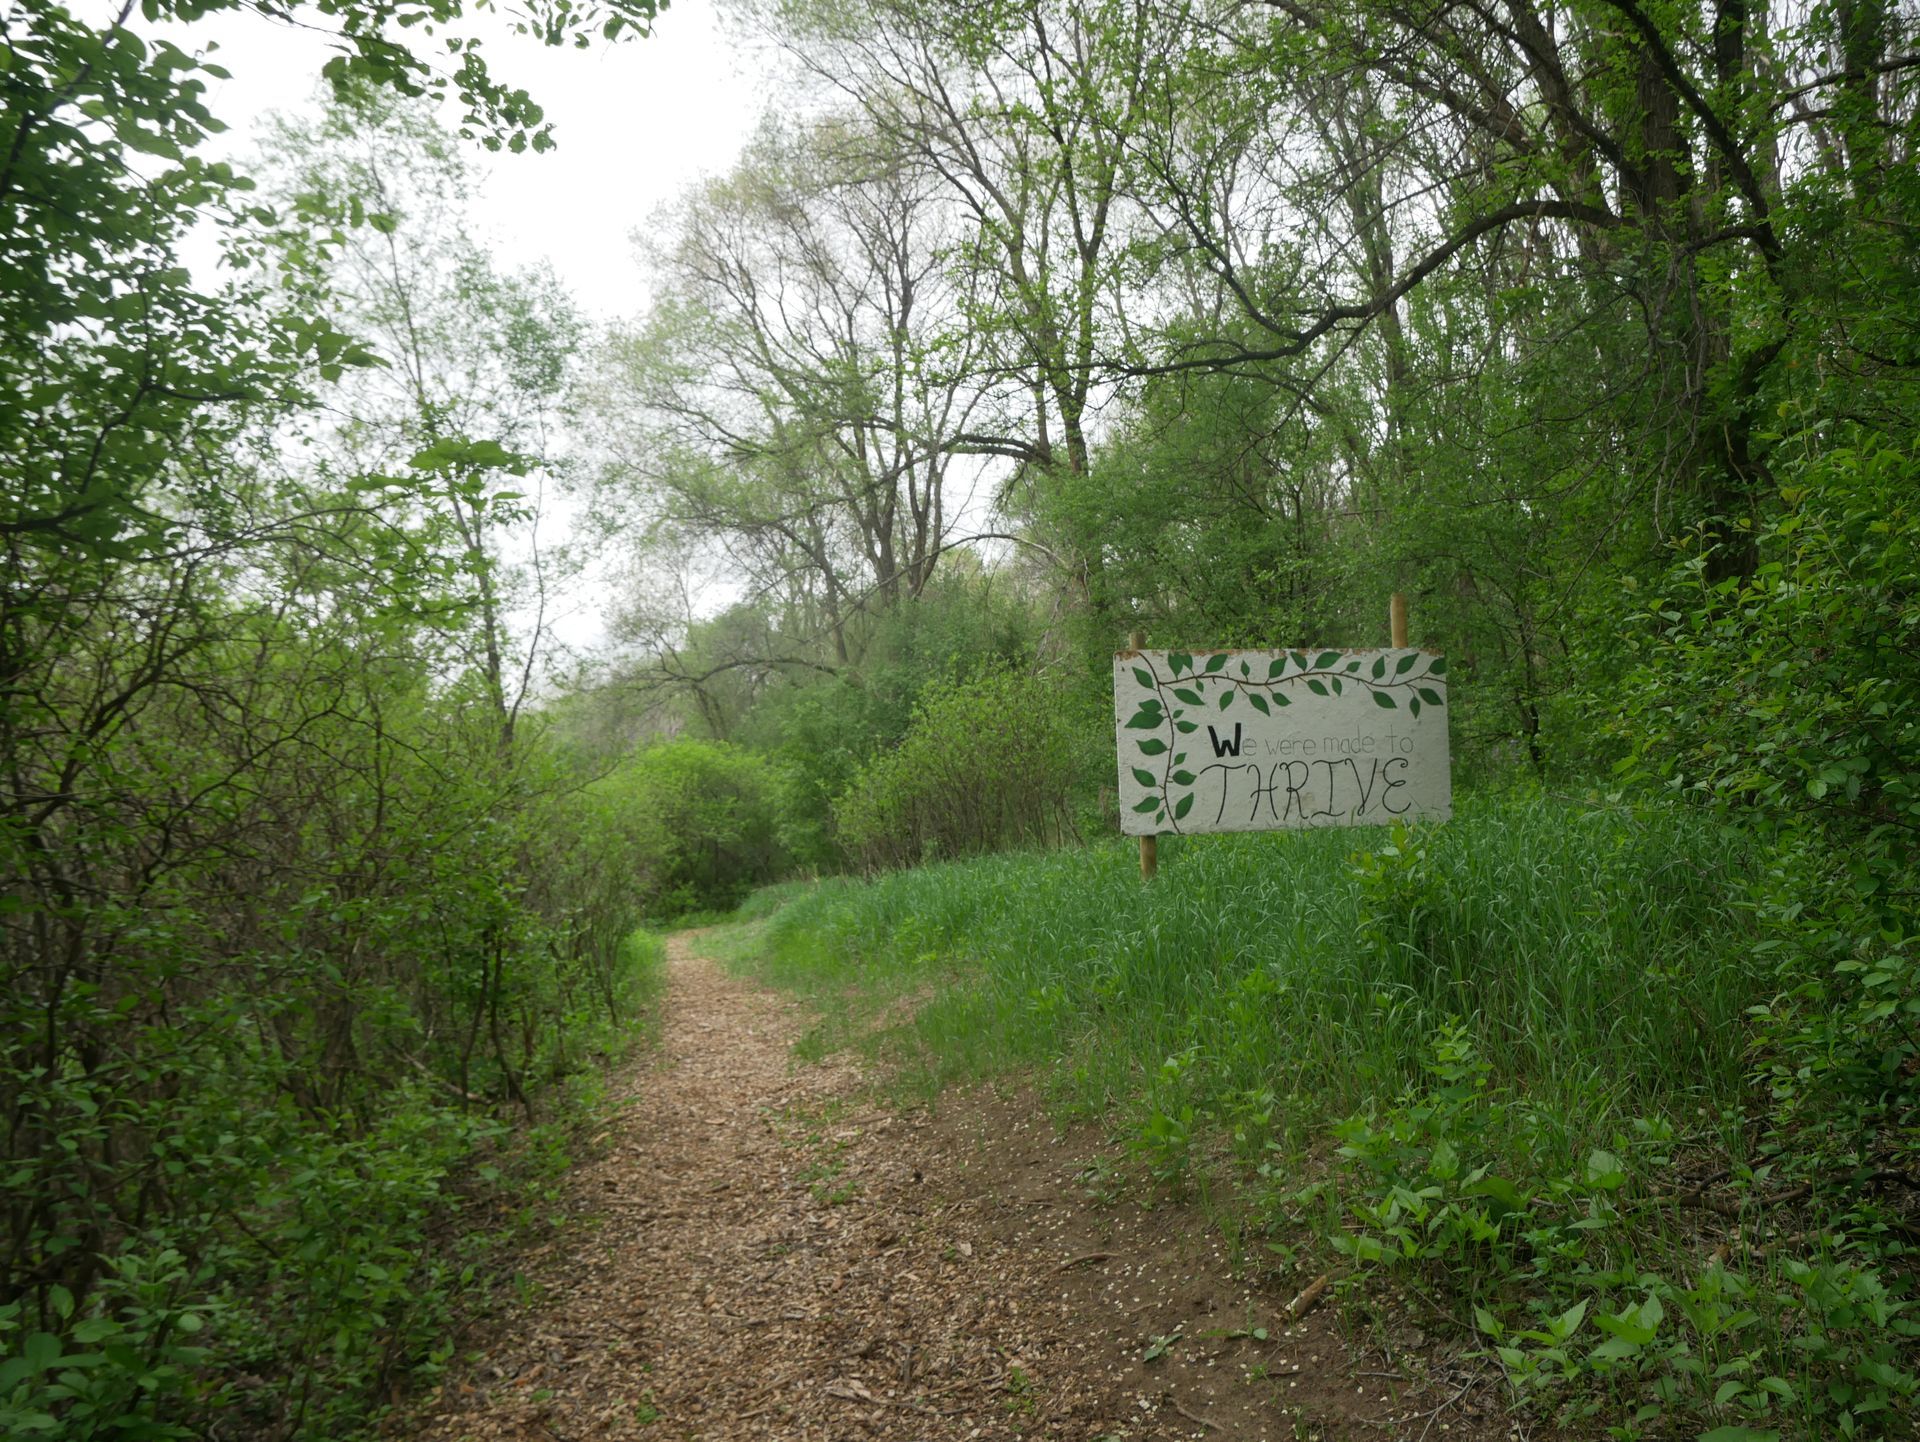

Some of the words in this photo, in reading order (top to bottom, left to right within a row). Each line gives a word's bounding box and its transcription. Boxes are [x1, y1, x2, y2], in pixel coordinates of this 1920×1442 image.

[1207, 722, 1257, 758] We
[1264, 737, 1317, 756] were
[1323, 724, 1375, 755] made
[1385, 724, 1415, 754] to
[1199, 757, 1413, 825] THRIVE
